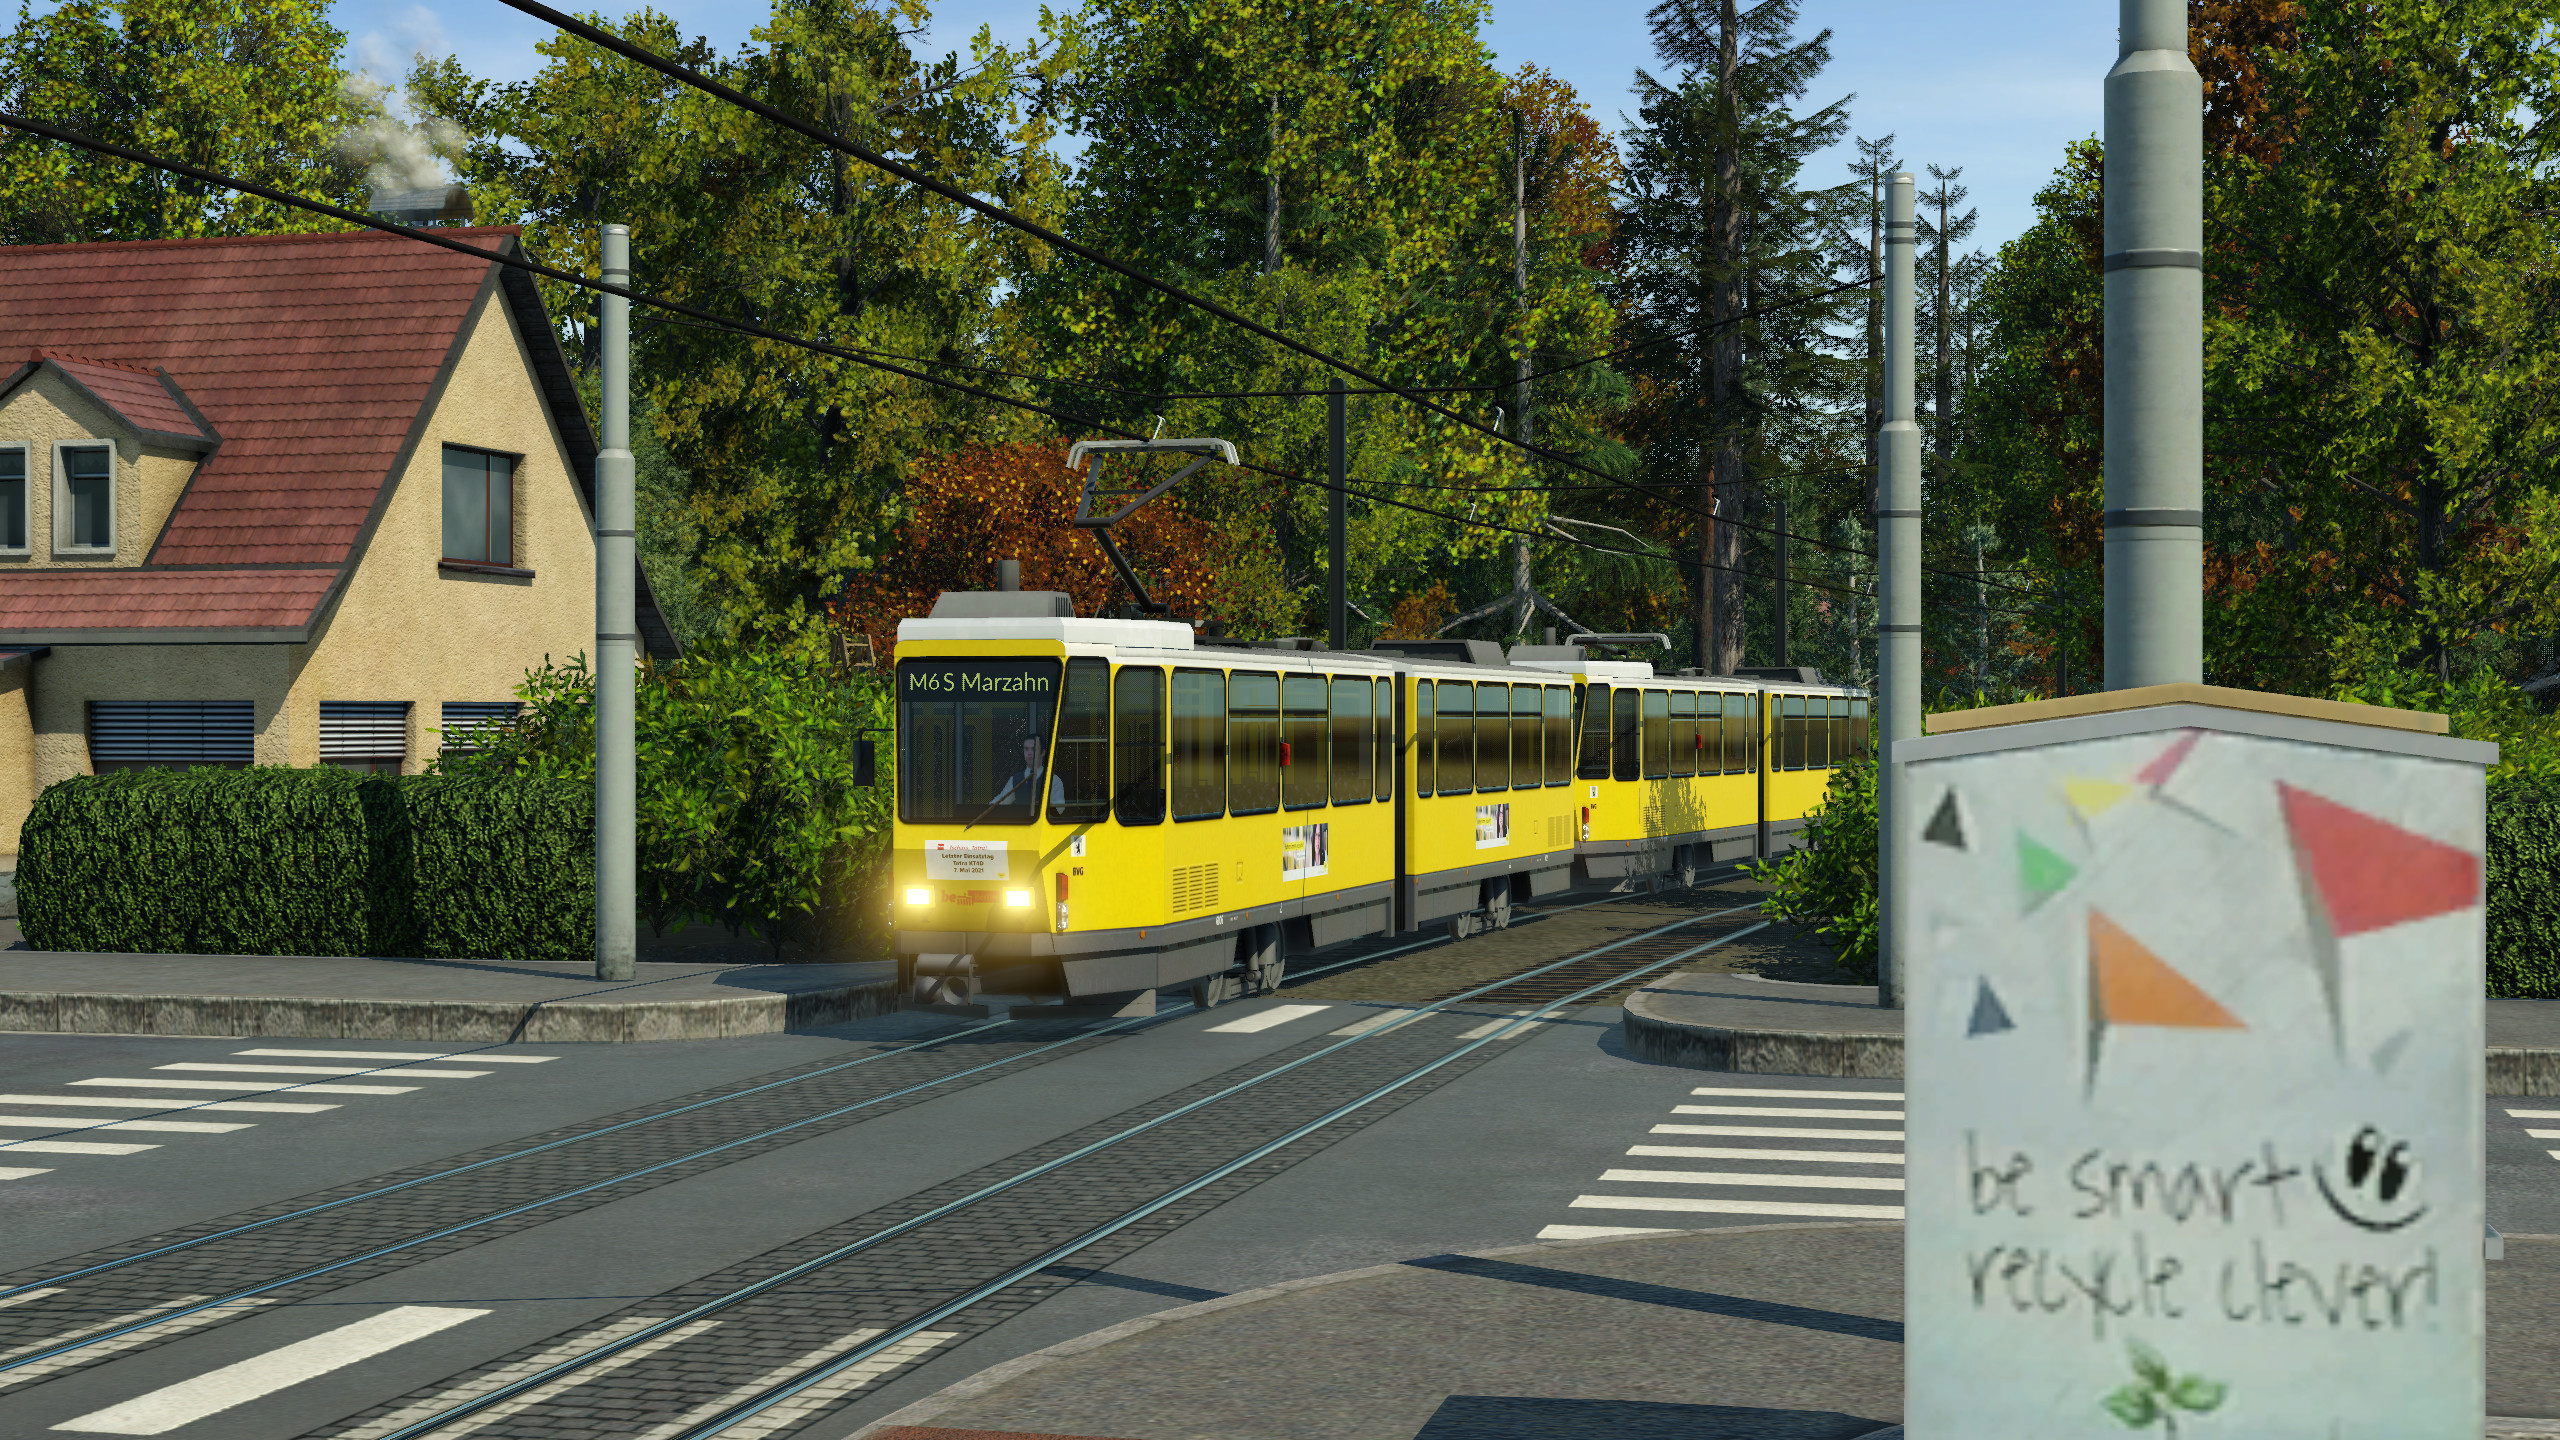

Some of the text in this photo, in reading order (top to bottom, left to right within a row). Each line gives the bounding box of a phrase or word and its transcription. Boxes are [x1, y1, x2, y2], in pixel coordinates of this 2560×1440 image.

[961, 671, 1049, 692] Marzahn
[1072, 866, 1084, 876] BVG
[1966, 1130, 2301, 1225] be smart
[1967, 1231, 2184, 1340] recycle
